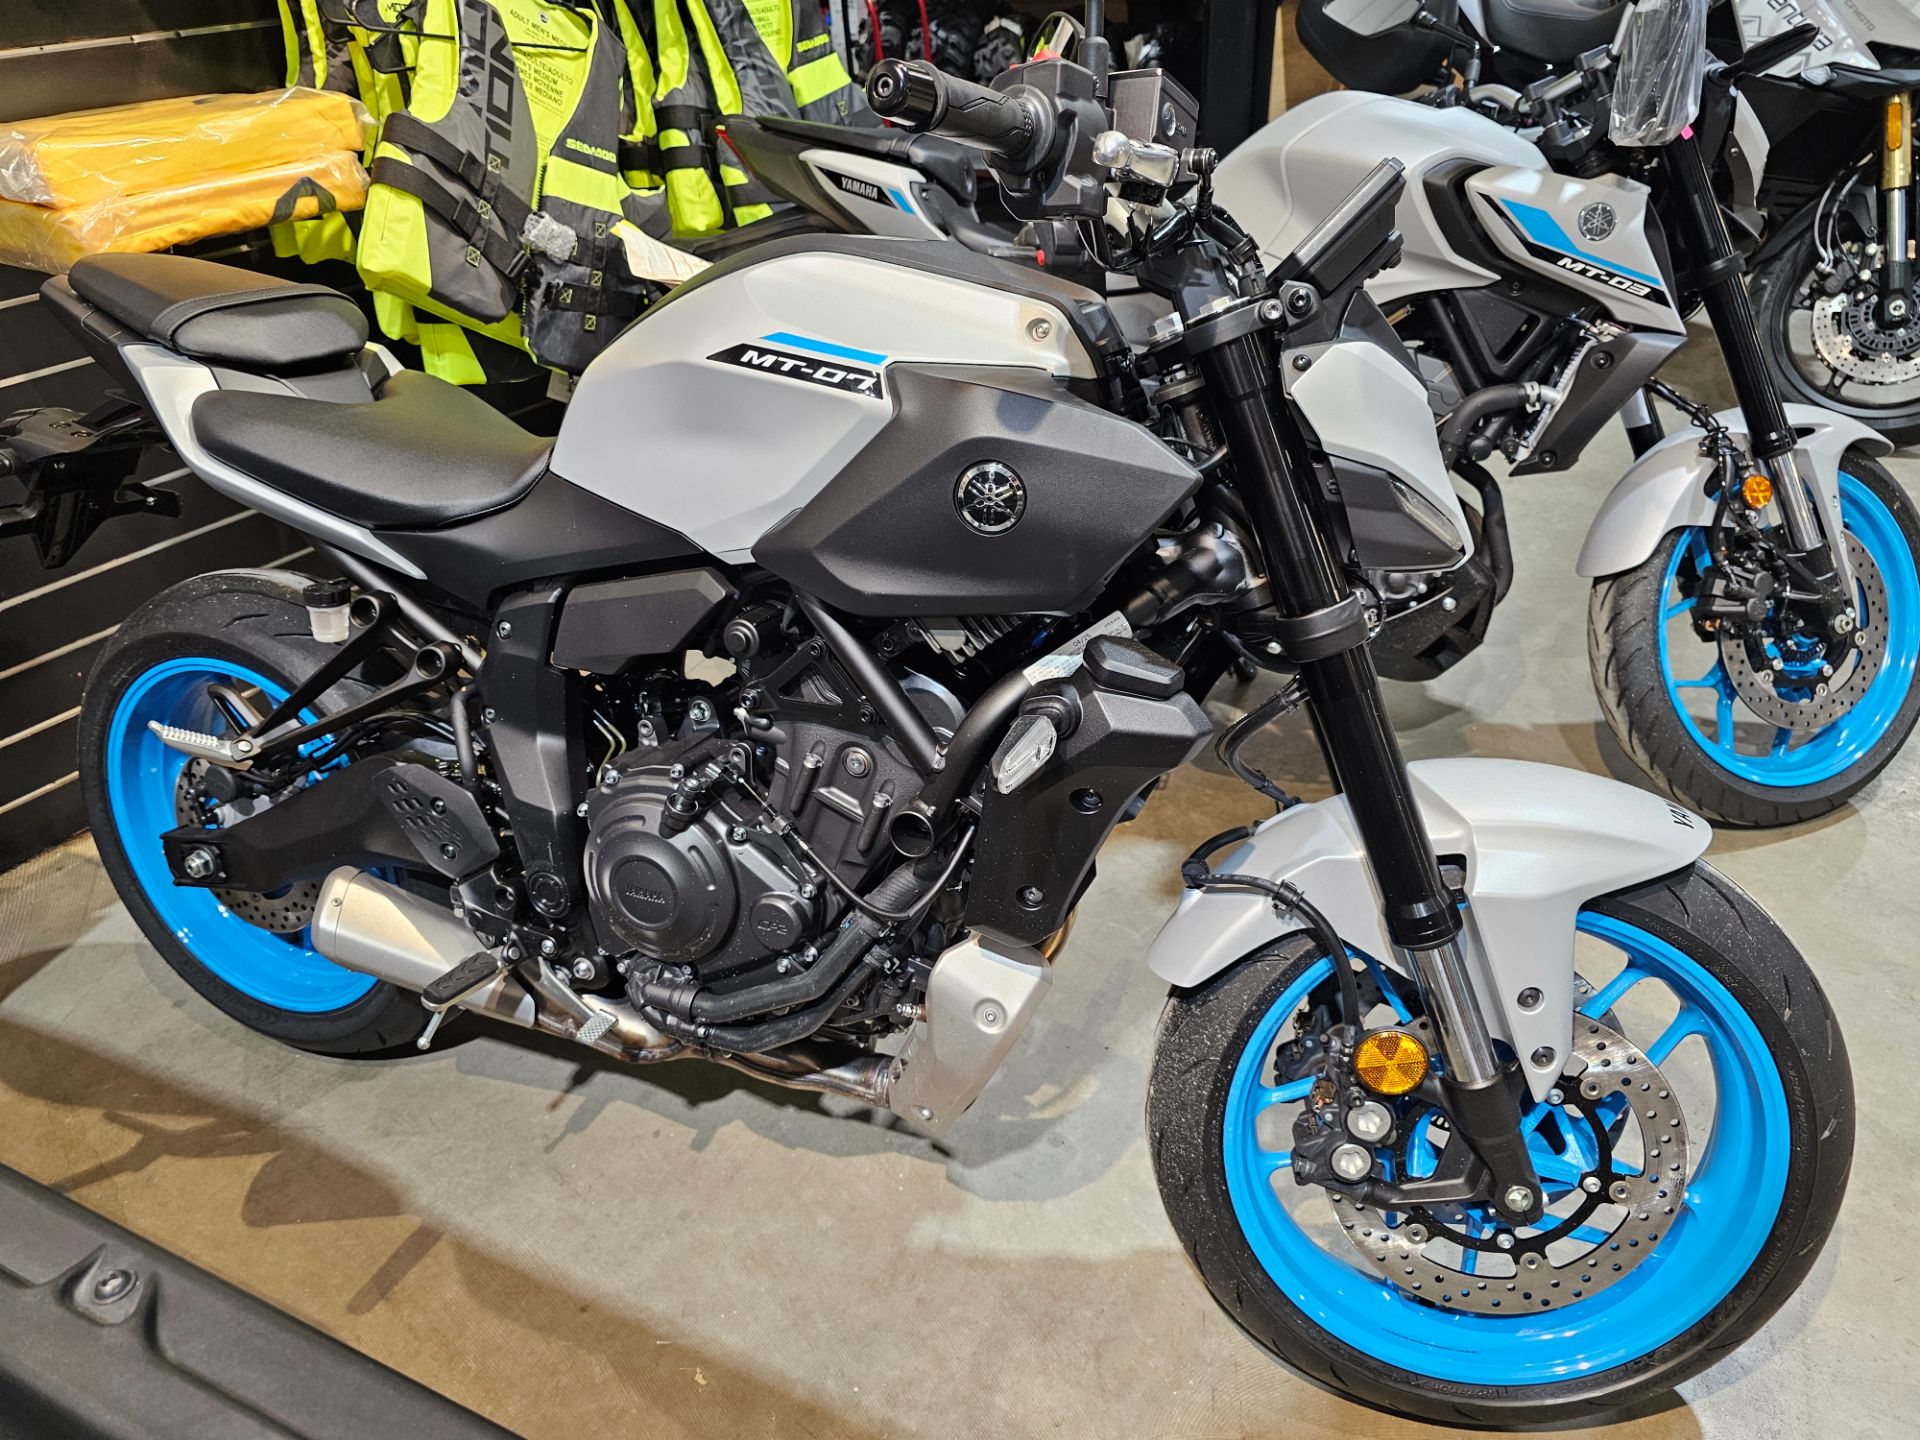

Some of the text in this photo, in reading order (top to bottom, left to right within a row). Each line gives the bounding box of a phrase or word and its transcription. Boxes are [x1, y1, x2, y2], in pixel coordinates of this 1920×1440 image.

[510, 9, 530, 25] ADULT
[533, 66, 558, 86] MEDIUM
[533, 75, 564, 97] MOYENNE
[535, 86, 563, 106] MEDIANO
[841, 176, 878, 200] YAMAHA
[1556, 257, 1652, 297] MT-03
[740, 350, 877, 391] MT-07
